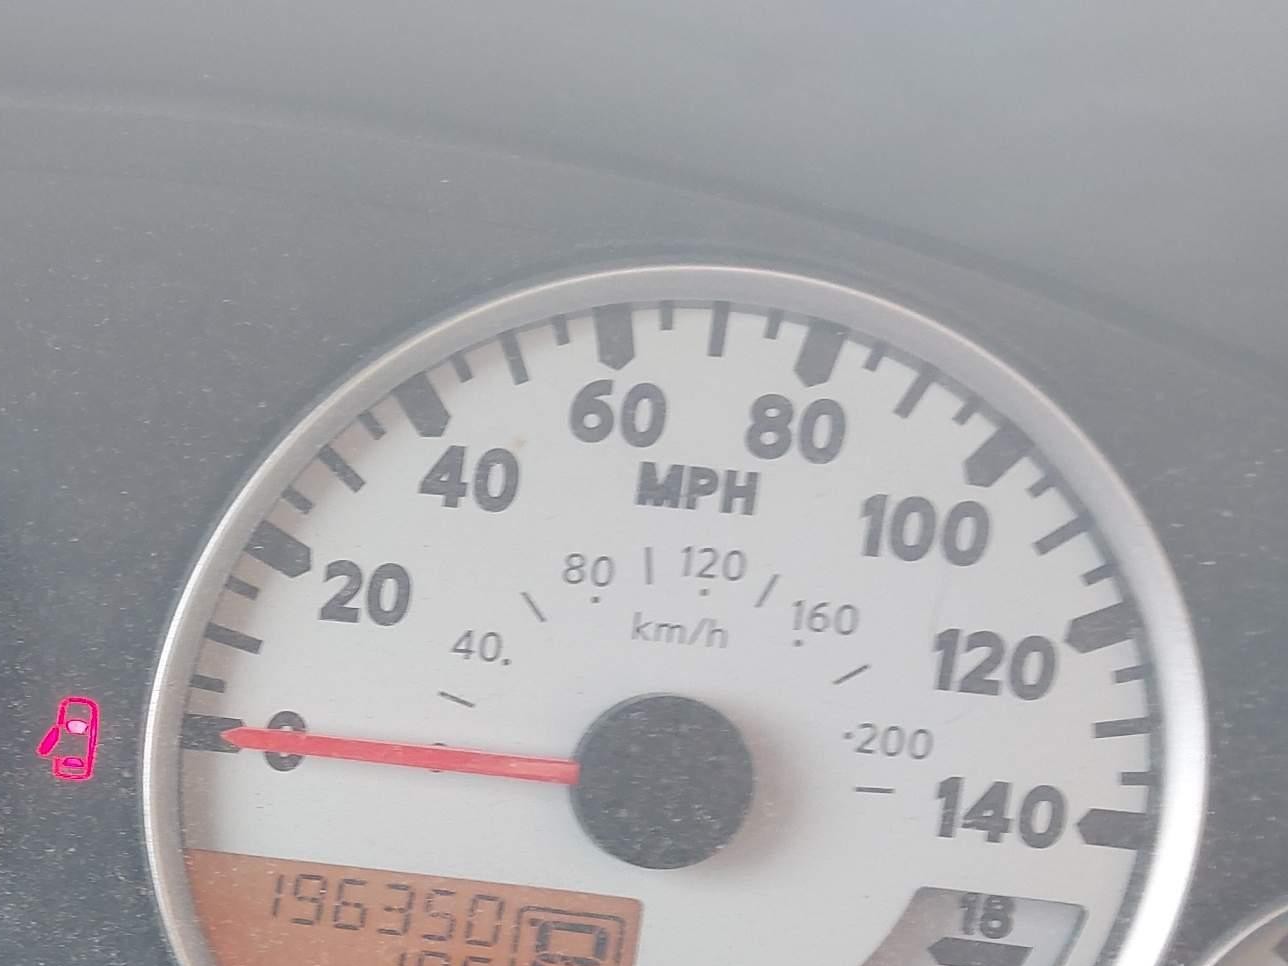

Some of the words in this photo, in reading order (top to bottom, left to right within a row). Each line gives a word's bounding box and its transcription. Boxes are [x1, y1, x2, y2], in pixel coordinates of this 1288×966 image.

[569, 379, 667, 447] 60
[745, 394, 845, 464] 80
[419, 446, 520, 513] 40
[635, 462, 760, 516] MPH
[860, 494, 990, 566] 100
[319, 560, 412, 626] 20
[563, 554, 614, 587] 80
[681, 547, 746, 581] 120
[451, 630, 503, 662] 40
[631, 613, 728, 649] km/h
[792, 600, 859, 636] 160
[933, 628, 1055, 700] 120
[855, 723, 934, 759] 200
[936, 776, 1066, 848] 140
[273, 874, 505, 947] 196350
